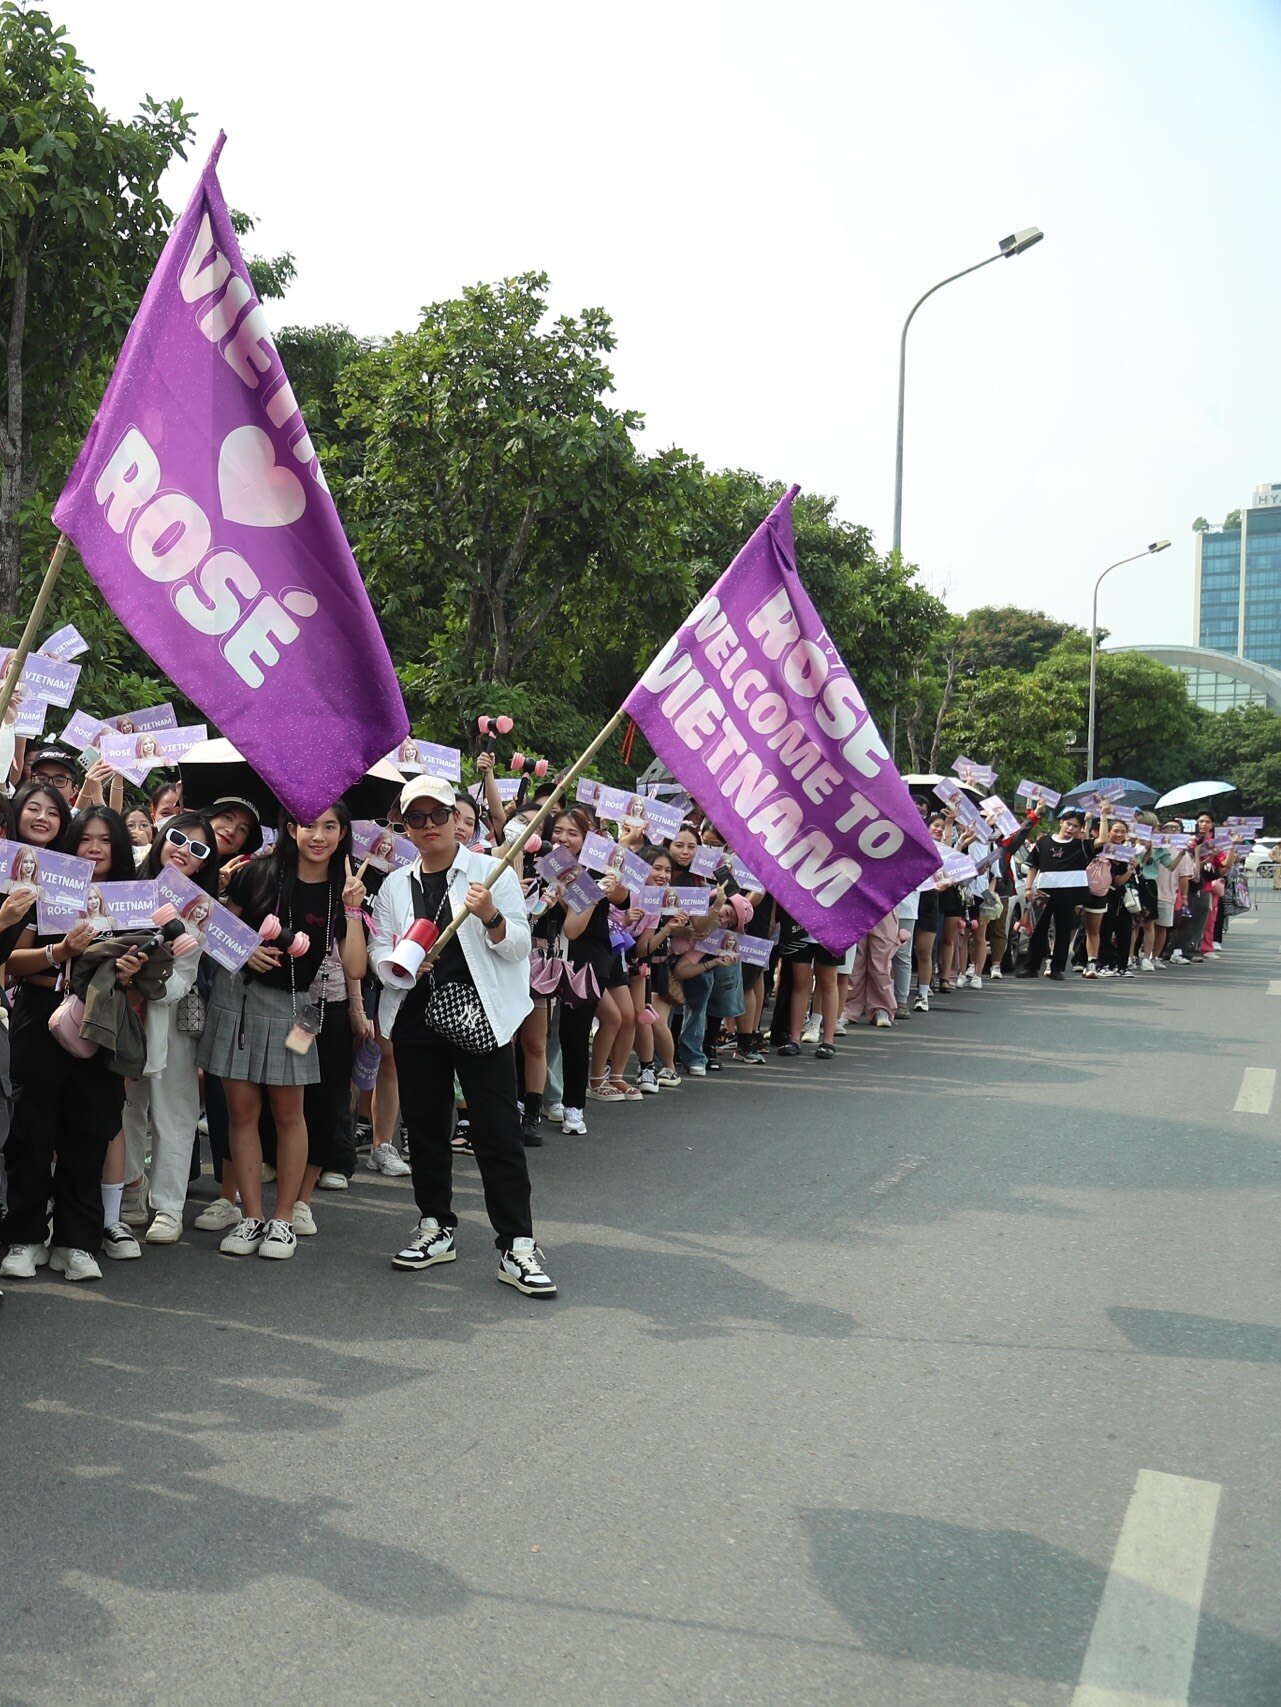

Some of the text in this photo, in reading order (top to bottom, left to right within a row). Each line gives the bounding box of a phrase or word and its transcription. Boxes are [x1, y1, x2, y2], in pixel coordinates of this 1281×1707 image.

[1258, 494, 1281, 504] HY
[96, 426, 318, 688] ROSÉ
[53, 635, 80, 655] VIETNAM
[24, 671, 70, 690] VIETNAM
[138, 717, 172, 732] VIETNAM
[685, 596, 904, 858] WELCOME TO
[73, 726, 92, 740] ROSÉ
[110, 748, 131, 757] ROSÉ
[422, 755, 456, 769] VIETNAM
[640, 638, 862, 908] VIETNAM
[605, 800, 624, 810] ROSÉ
[647, 811, 677, 828] VIETNAM
[588, 848, 607, 860] ROSÉ
[548, 858, 564, 872] ROSÉ
[699, 858, 714, 868] ROSÉ
[41, 870, 84, 891] VIETNAM
[624, 864, 644, 883] VIETNAM
[158, 884, 184, 906] ROSÉ
[572, 884, 592, 905] VIETNAM
[108, 900, 153, 912] VIETNAM
[208, 922, 246, 958] VIETNAM
[739, 945, 766, 956] VIETNAM
